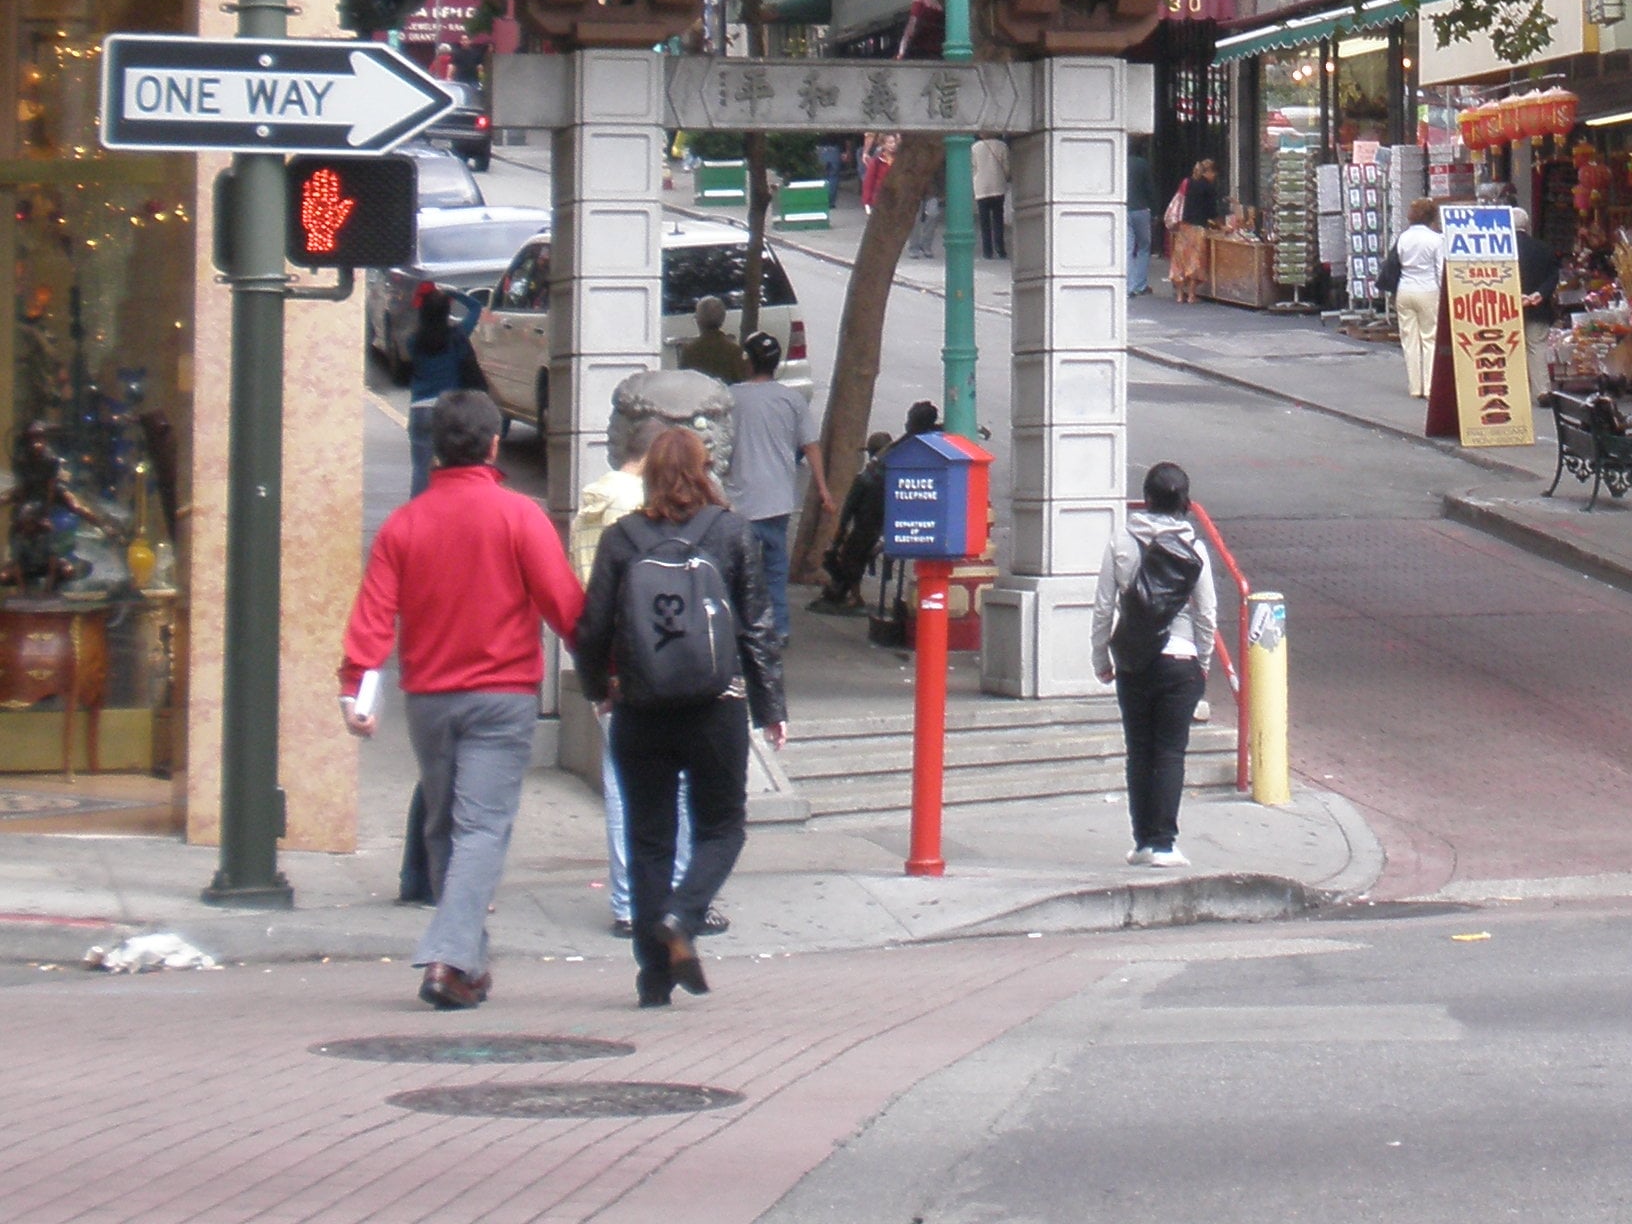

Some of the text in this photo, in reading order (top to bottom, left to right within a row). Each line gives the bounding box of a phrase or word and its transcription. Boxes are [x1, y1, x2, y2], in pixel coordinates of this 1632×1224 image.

[136, 75, 334, 117] ONE WAY
[1450, 234, 1513, 254] ATM
[1468, 267, 1499, 278] SALE
[1453, 288, 1519, 327] DIGITAL
[1474, 329, 1512, 425] CAMERAS
[895, 491, 938, 500] TELEPHONE
[898, 479, 934, 489] POLICE
[653, 593, 686, 652] Y-3
